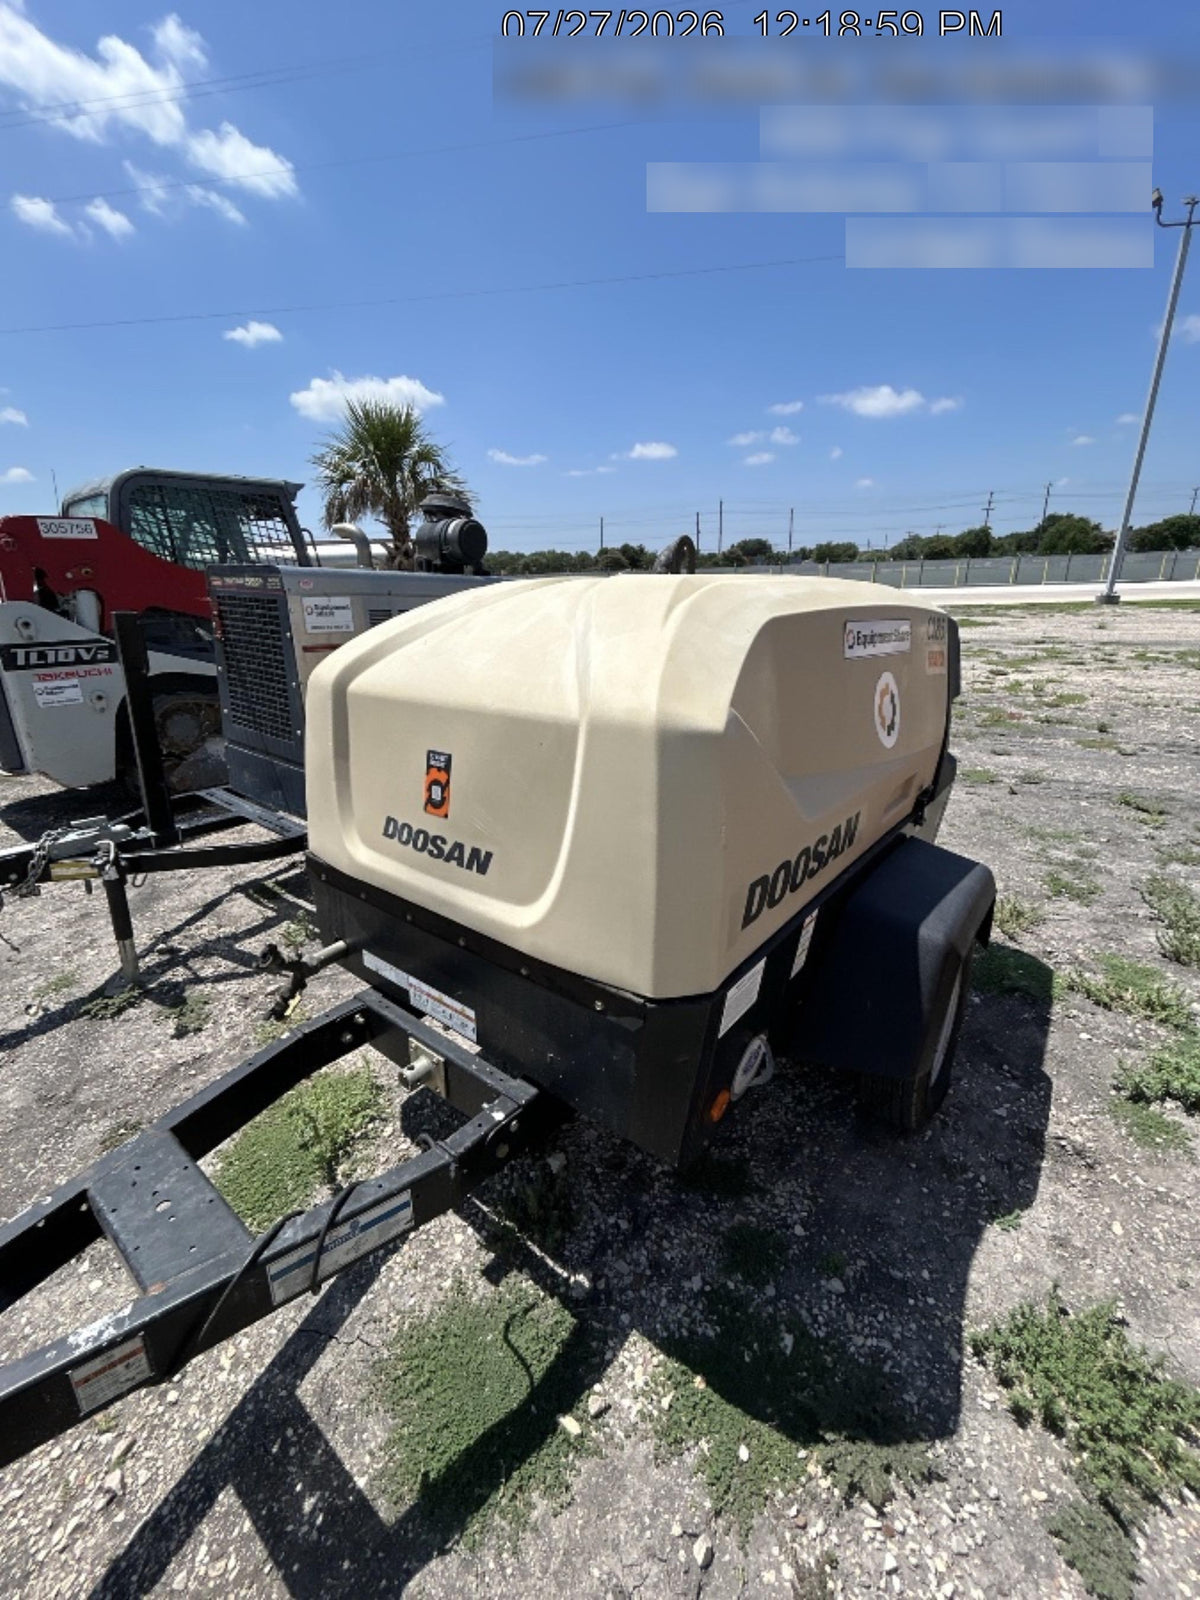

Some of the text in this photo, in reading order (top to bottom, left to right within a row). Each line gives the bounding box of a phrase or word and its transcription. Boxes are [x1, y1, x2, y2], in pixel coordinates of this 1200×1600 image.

[40, 522, 94, 535] 305756
[10, 646, 110, 666] TL10V2
[382, 815, 493, 876] DOOSAN
[741, 810, 861, 930] DOOSAN
